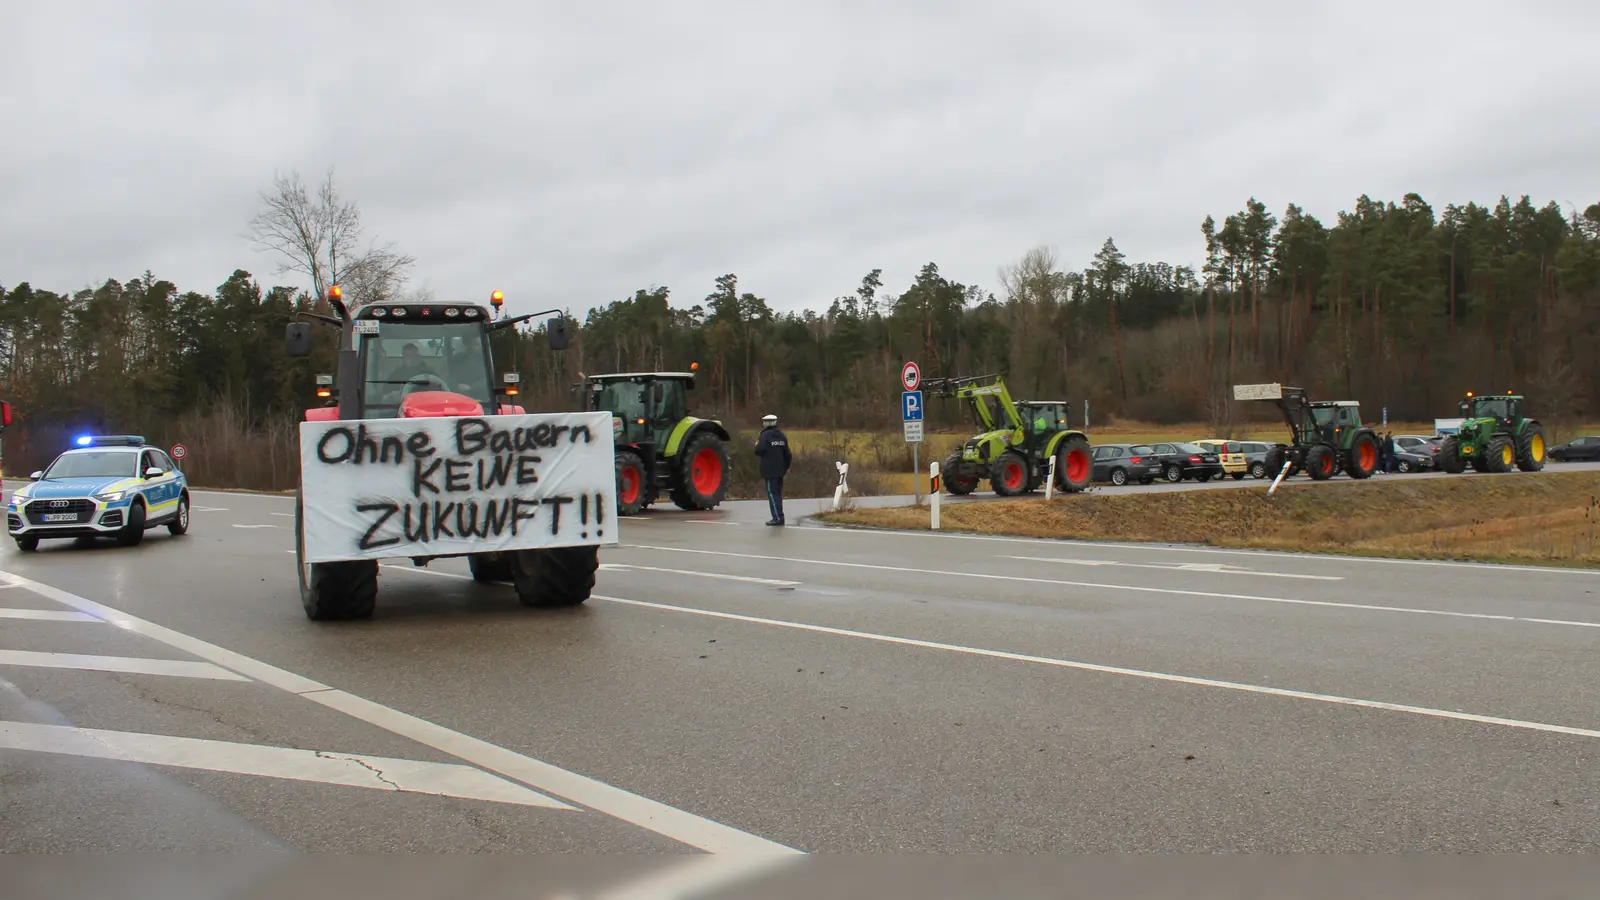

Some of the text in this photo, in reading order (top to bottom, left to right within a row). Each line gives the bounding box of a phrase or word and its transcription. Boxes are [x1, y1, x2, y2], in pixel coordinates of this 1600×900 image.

[317, 418, 593, 464] Ohne Bauern
[413, 454, 542, 497] KEINE
[356, 492, 604, 550] ZUKUNFT!!
